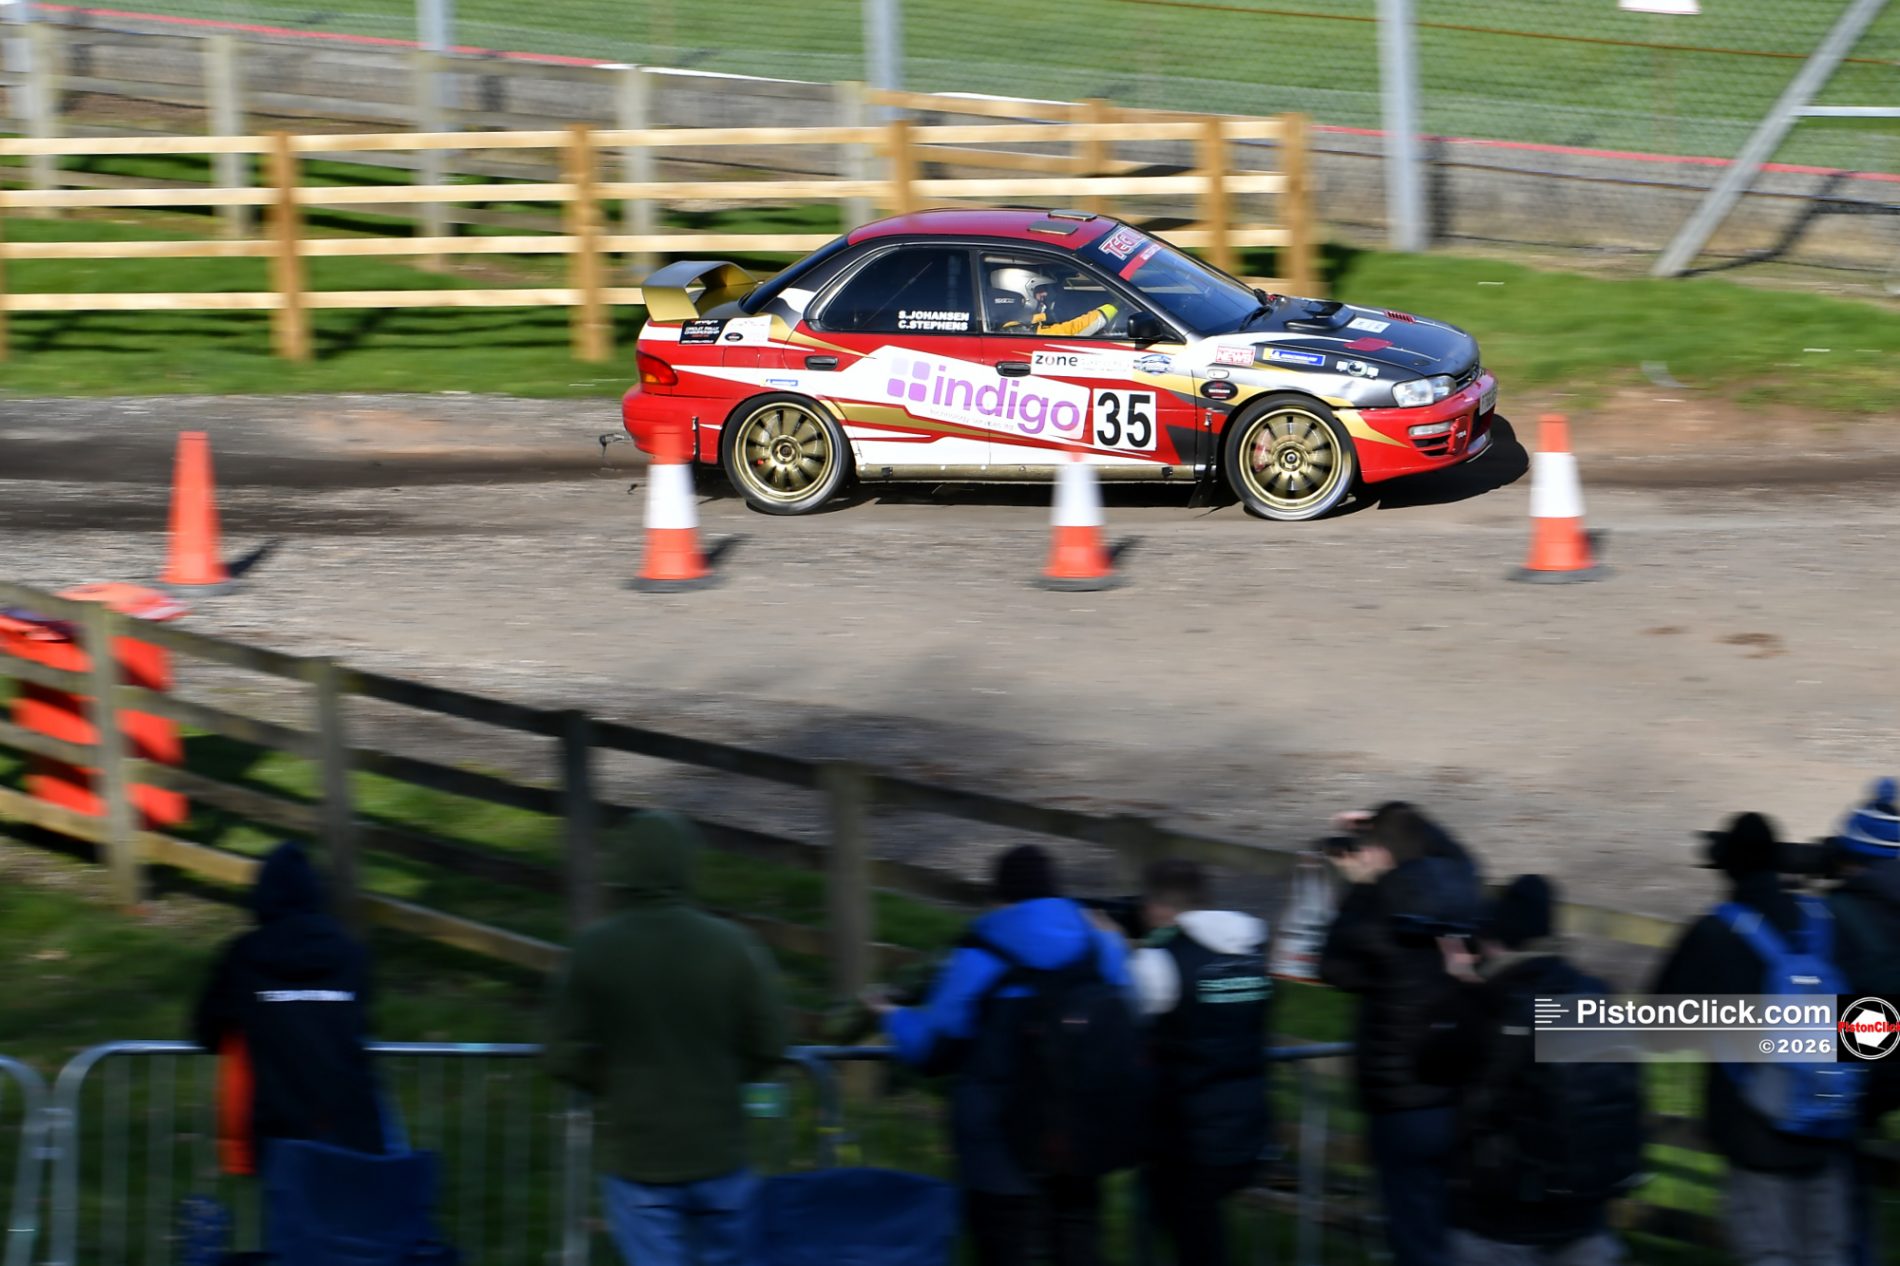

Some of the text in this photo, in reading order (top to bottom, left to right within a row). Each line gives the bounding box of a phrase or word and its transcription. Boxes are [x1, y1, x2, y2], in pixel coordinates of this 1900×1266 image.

[898, 320, 968, 331] C.STEPHENS
[1035, 354, 1079, 367] zone
[1216, 350, 1255, 364] NEWS
[932, 364, 1081, 435] indigo
[1096, 391, 1152, 449] 35
